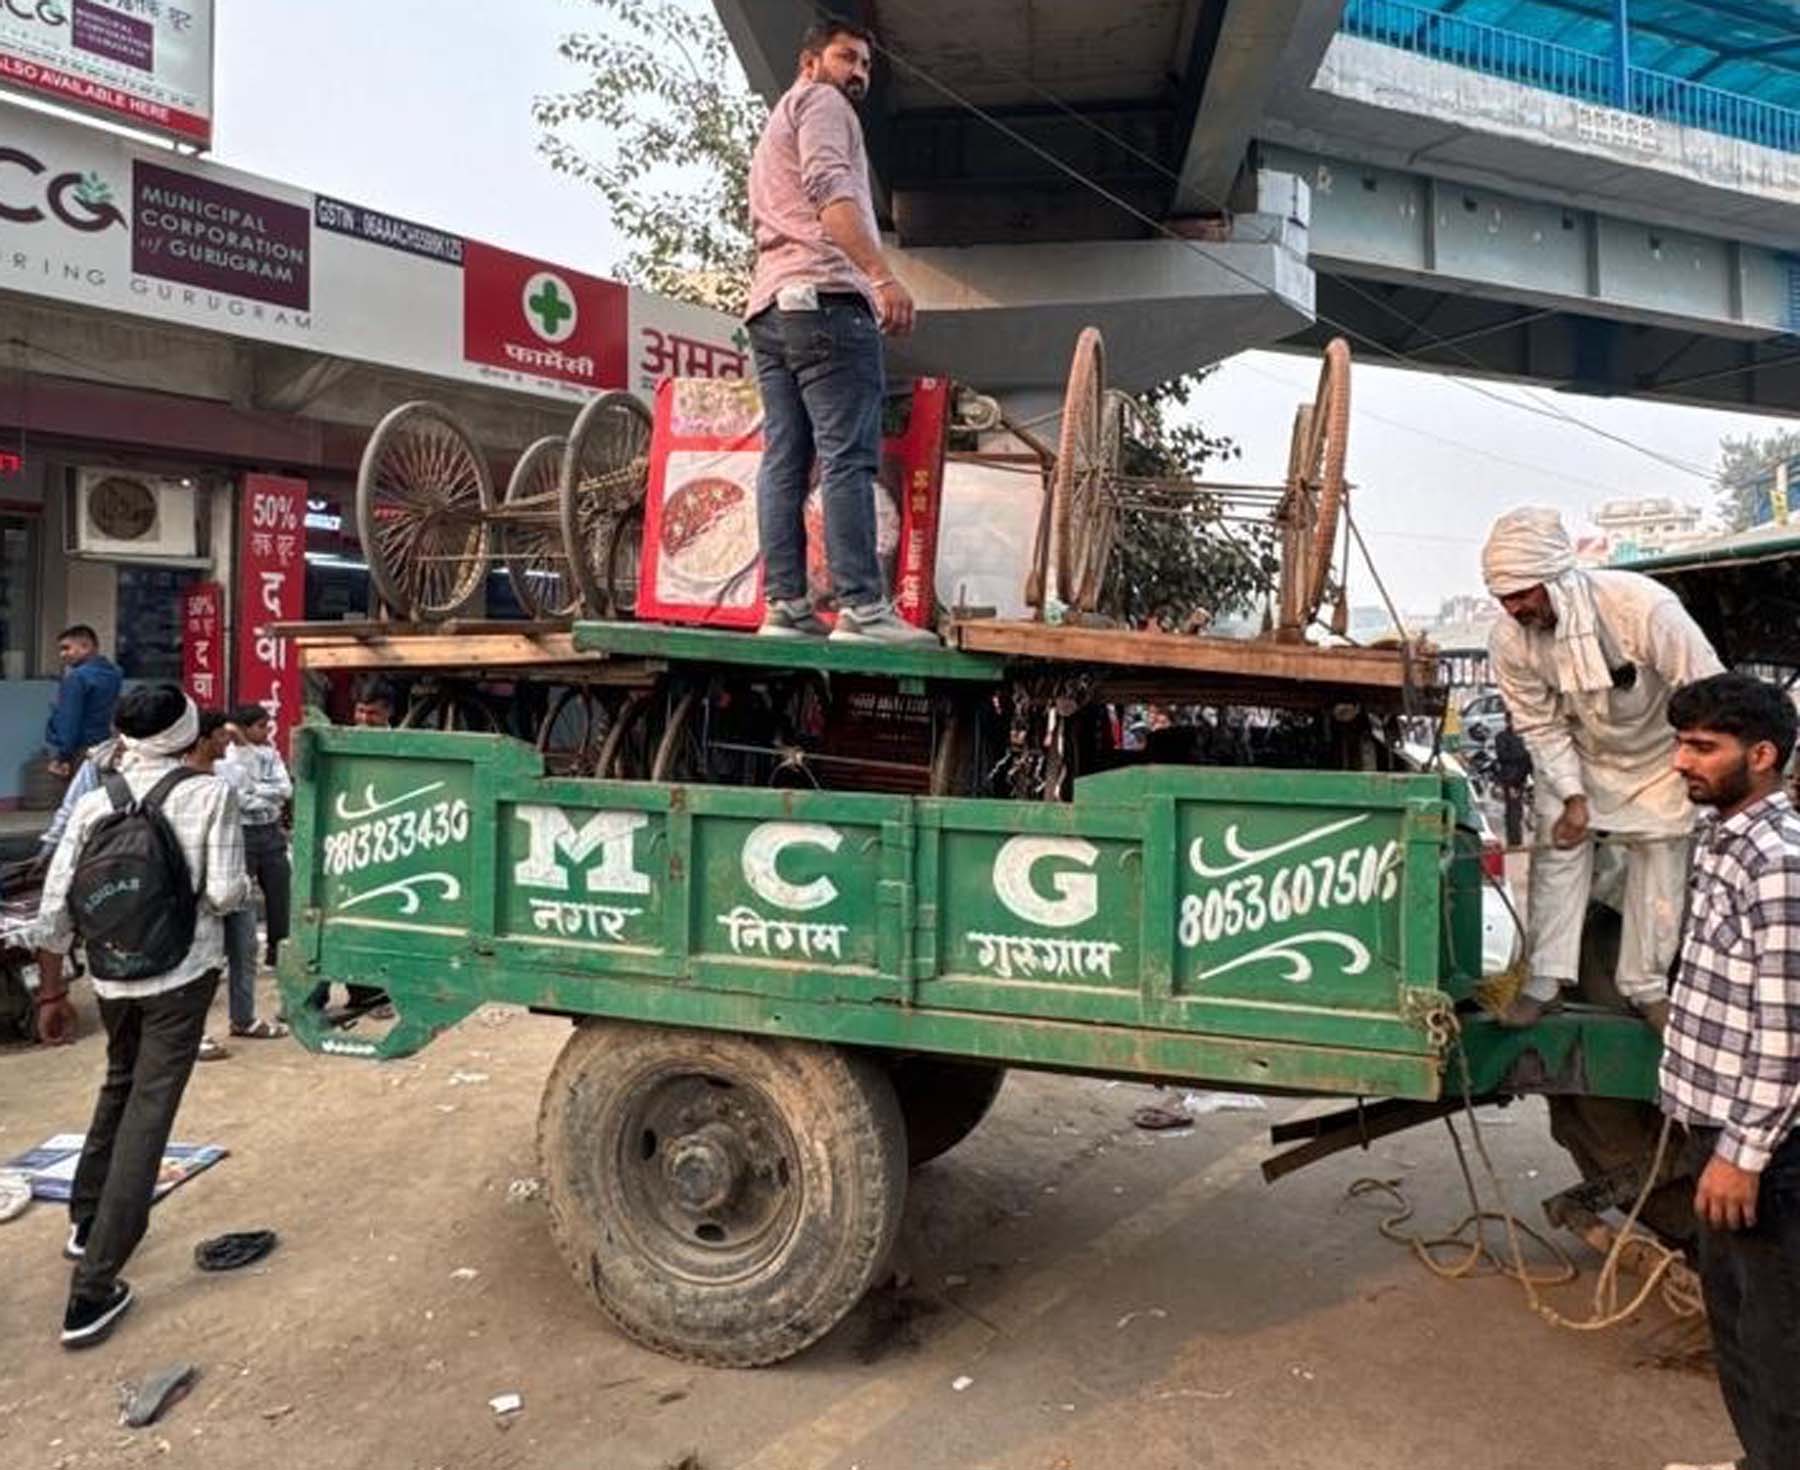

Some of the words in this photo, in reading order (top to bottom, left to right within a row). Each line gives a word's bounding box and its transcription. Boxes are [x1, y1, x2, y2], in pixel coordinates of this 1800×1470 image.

[40, 69, 127, 108] AVAILABLE
[128, 98, 170, 123] HERE
[141, 187, 267, 233] MUNICIPAL
[141, 209, 304, 263] CORPORATION
[318, 198, 355, 231] GSTIN
[169, 239, 295, 283] GURUGRAM
[130, 279, 312, 331] GURUGRAM
[252, 492, 297, 530] 50%
[514, 804, 651, 895] M
[741, 822, 844, 911] C
[992, 833, 1099, 928] G
[529, 897, 644, 941] नगर
[716, 905, 848, 959] निगम
